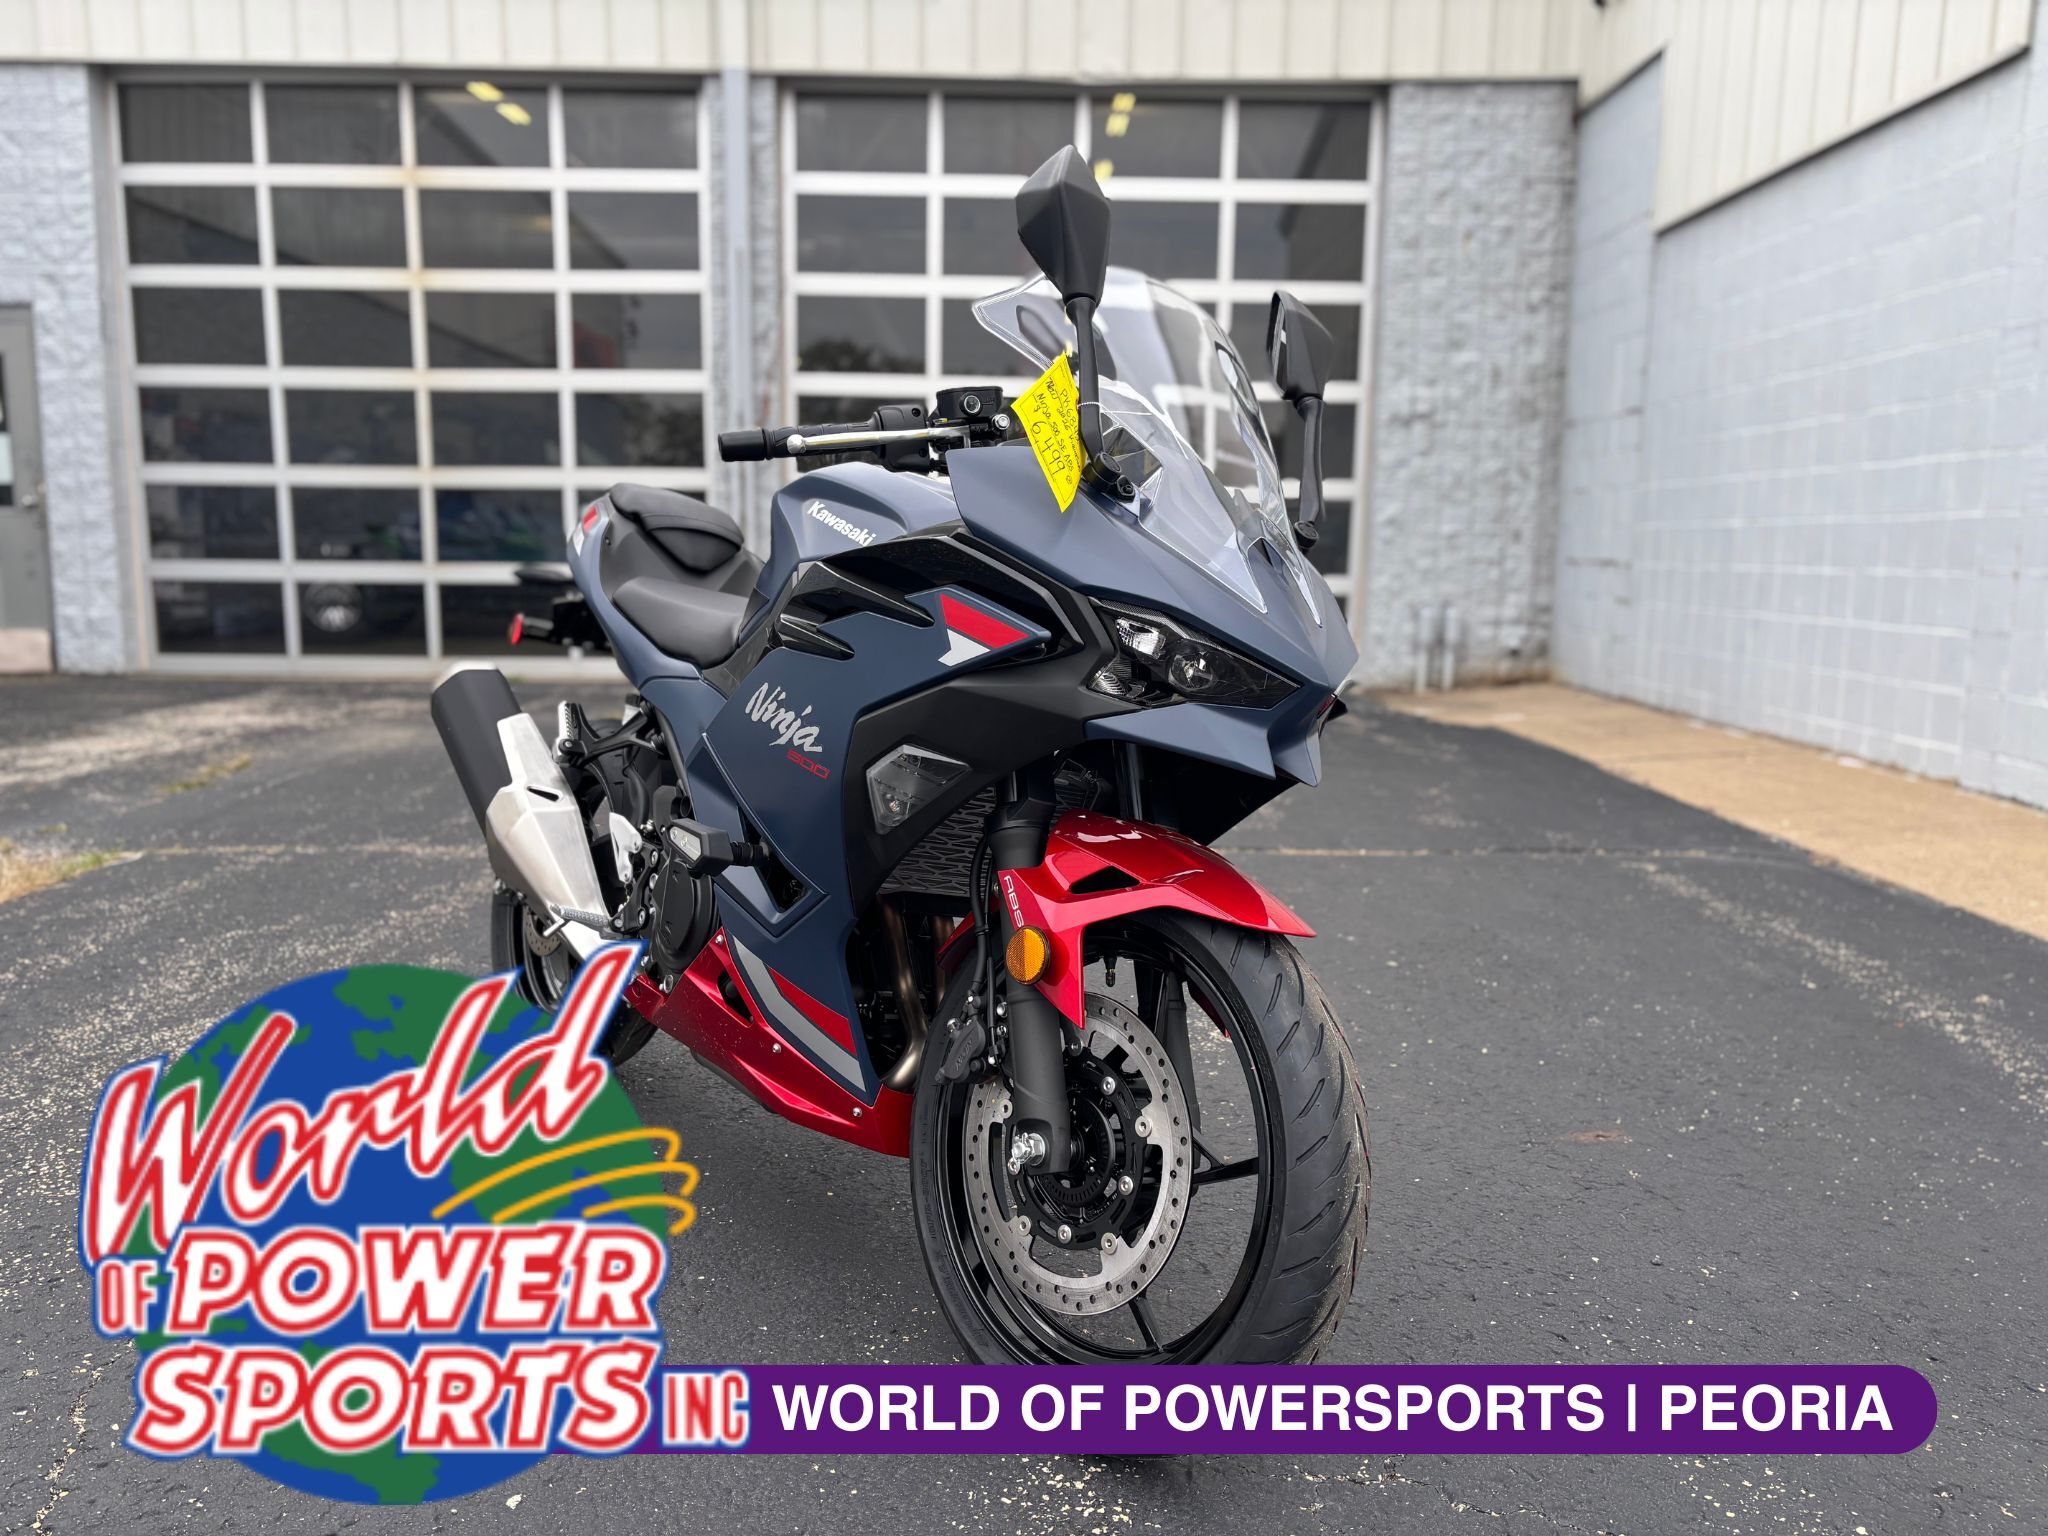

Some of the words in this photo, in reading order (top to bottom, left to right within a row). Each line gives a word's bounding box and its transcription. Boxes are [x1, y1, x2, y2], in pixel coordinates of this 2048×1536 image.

[1037, 393, 1052, 419] Ninja
[807, 501, 877, 547] Kawasaki
[745, 681, 823, 753] Ninja
[787, 749, 830, 780] 500
[1003, 874, 1025, 929] ABS
